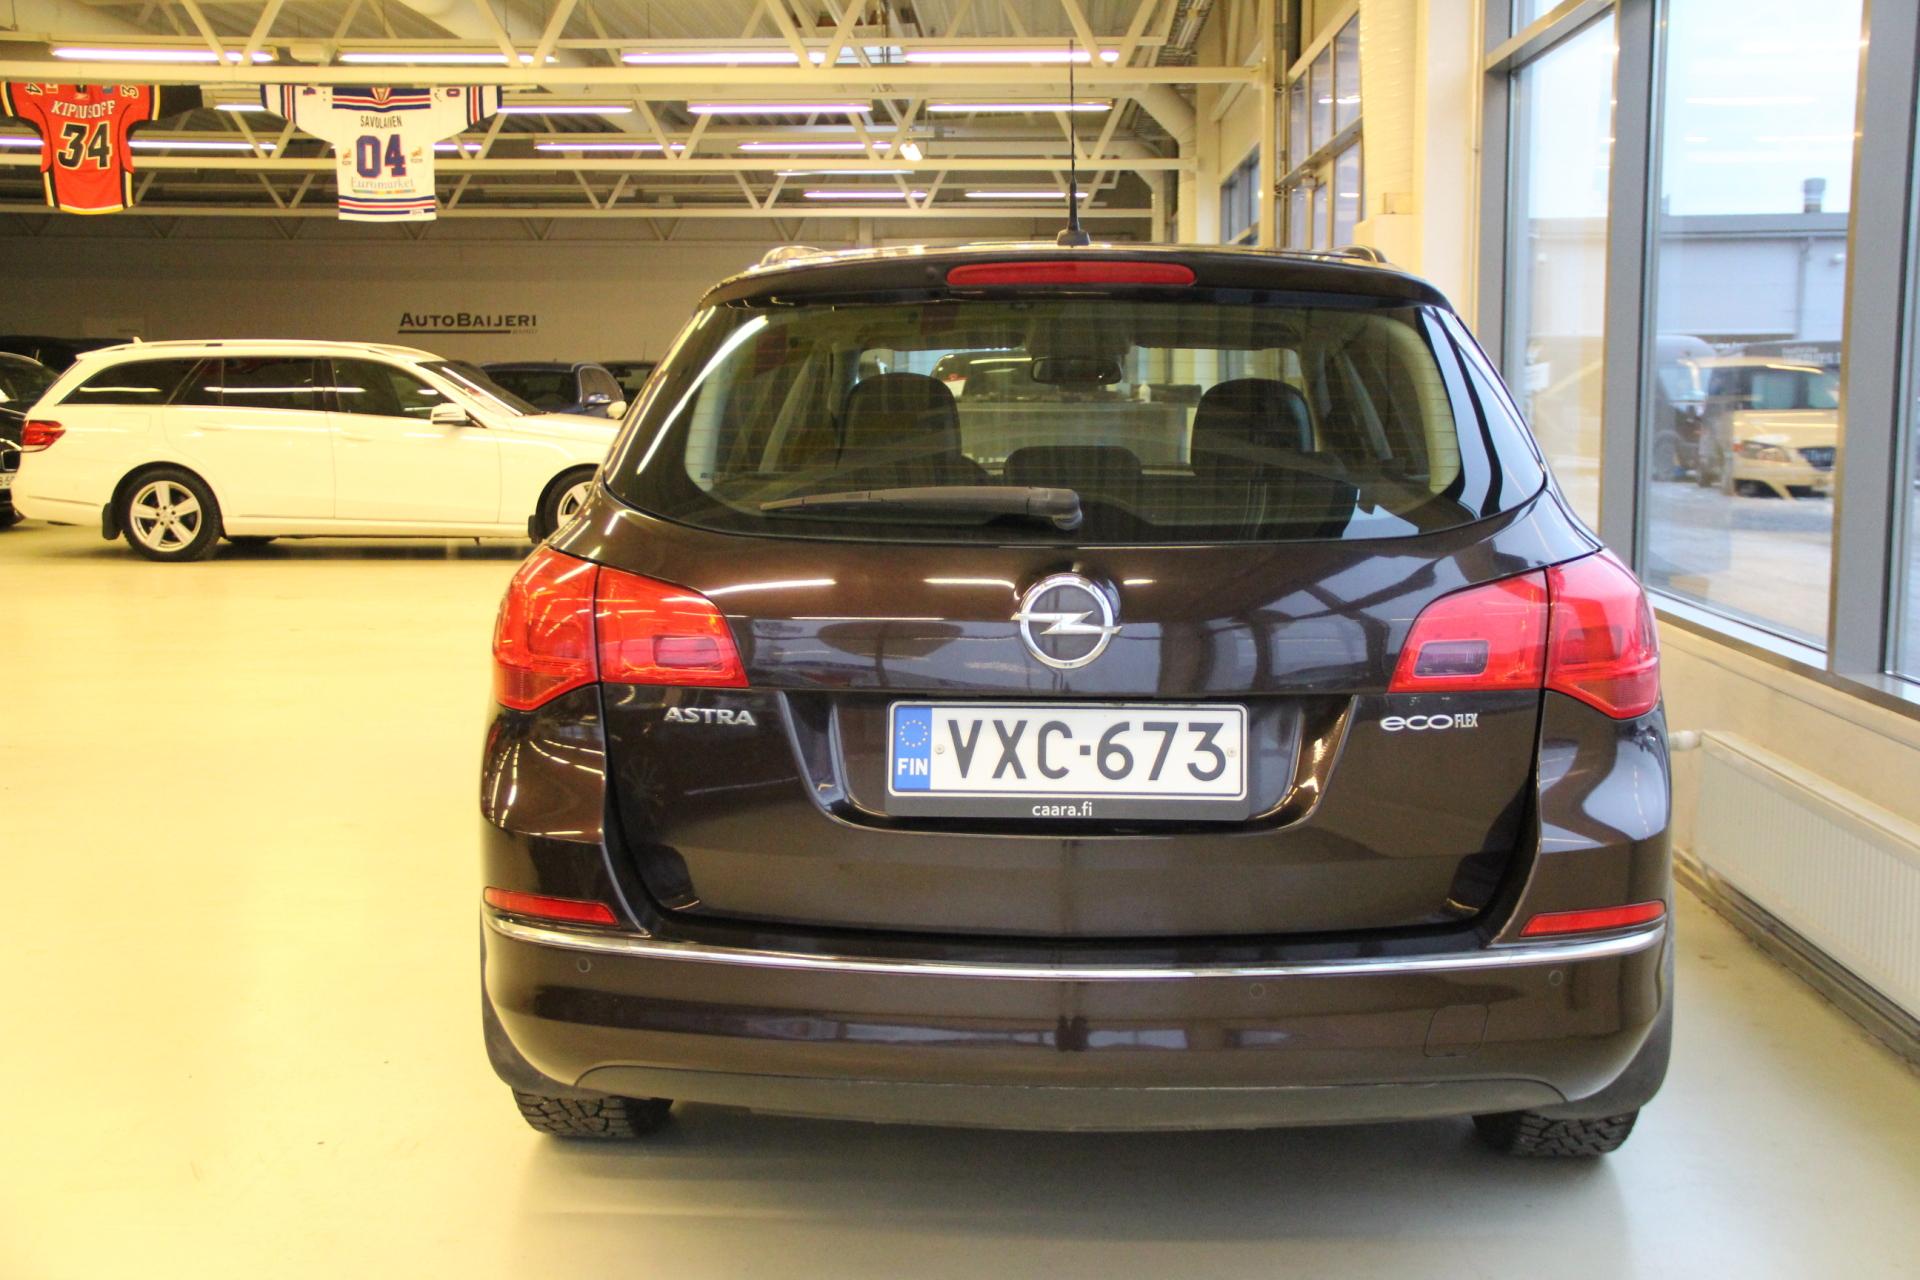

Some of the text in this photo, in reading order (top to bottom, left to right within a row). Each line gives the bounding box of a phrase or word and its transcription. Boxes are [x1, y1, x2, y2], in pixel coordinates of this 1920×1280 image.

[57, 121, 112, 170] 34
[356, 134, 407, 178] 04
[400, 312, 537, 327] AUTOBAIJERI
[664, 707, 757, 726] ASTRA
[897, 719, 1227, 782] FIN VXC-673
[1032, 801, 1093, 817] caara.fi
